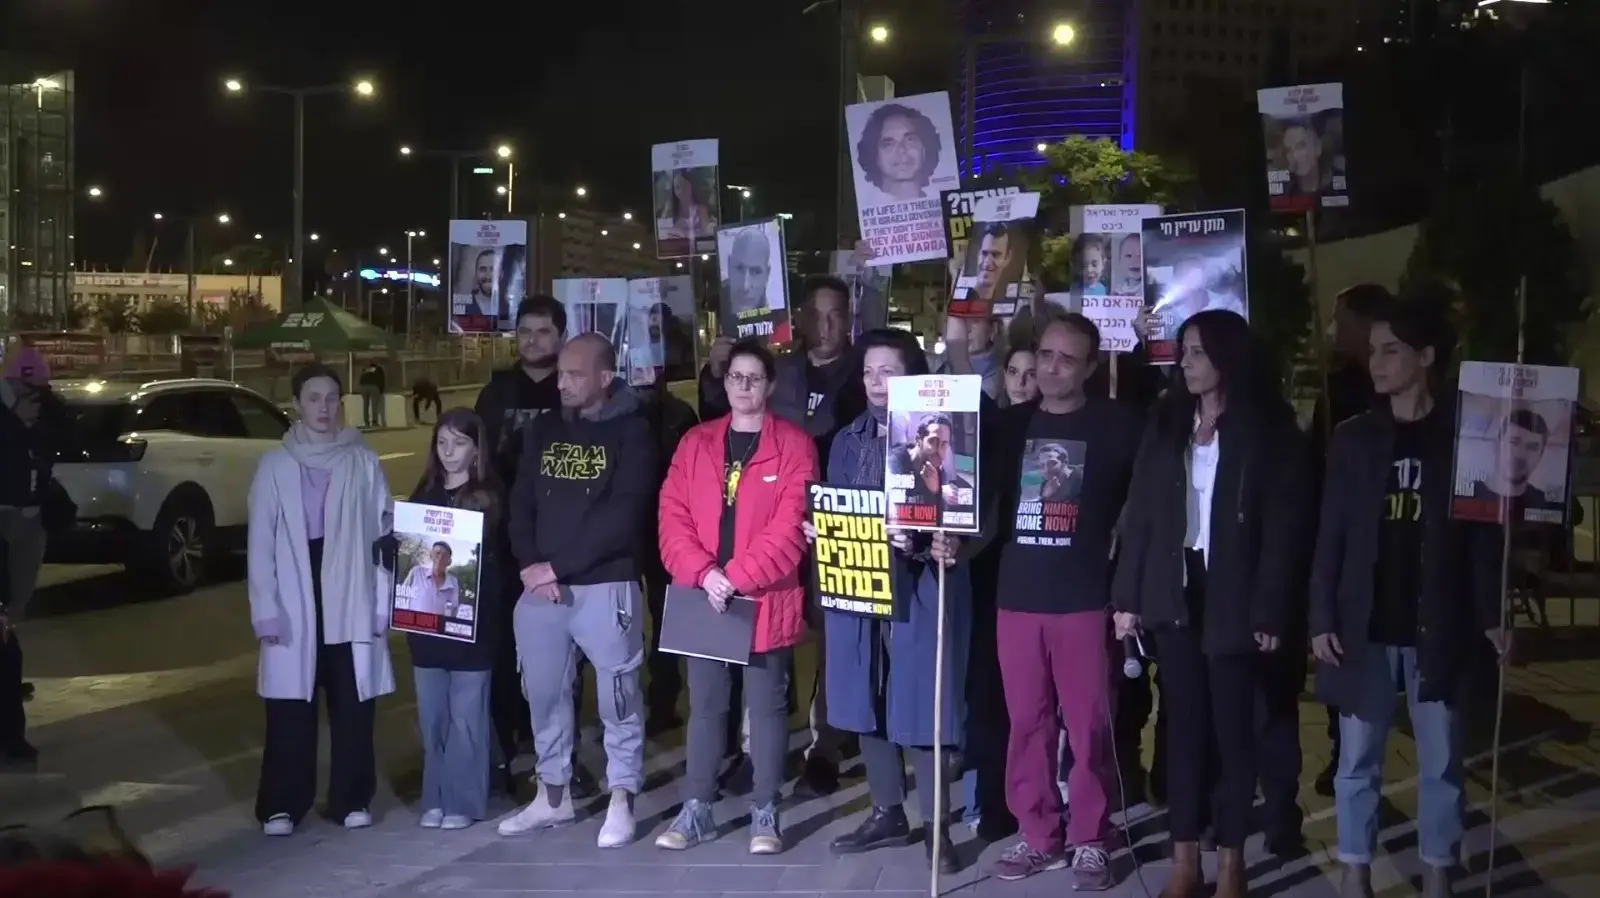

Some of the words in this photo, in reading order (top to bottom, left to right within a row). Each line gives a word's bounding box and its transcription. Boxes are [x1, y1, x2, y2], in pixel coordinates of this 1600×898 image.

[863, 208, 874, 217] MY
[876, 204, 896, 215] LIFE
[910, 201, 927, 211] THE
[1159, 222, 1173, 236] חי
[1175, 219, 1201, 237] עדיין
[868, 236, 890, 248] THEY
[891, 232, 910, 245] ARE
[872, 244, 904, 259] EATH
[1081, 297, 1099, 308] הם
[1103, 298, 1121, 309] אם
[1126, 298, 1143, 309] מה
[540, 458, 606, 480] WARS
[810, 484, 886, 515] חנוכה?
[914, 504, 937, 521] NOW!
[1017, 502, 1043, 515] BRING
[812, 511, 888, 541] חטופים
[1015, 514, 1043, 531] HOME
[1044, 516, 1077, 533] NOW!
[816, 536, 889, 570] חנוקים
[818, 563, 893, 601] בעזה!
